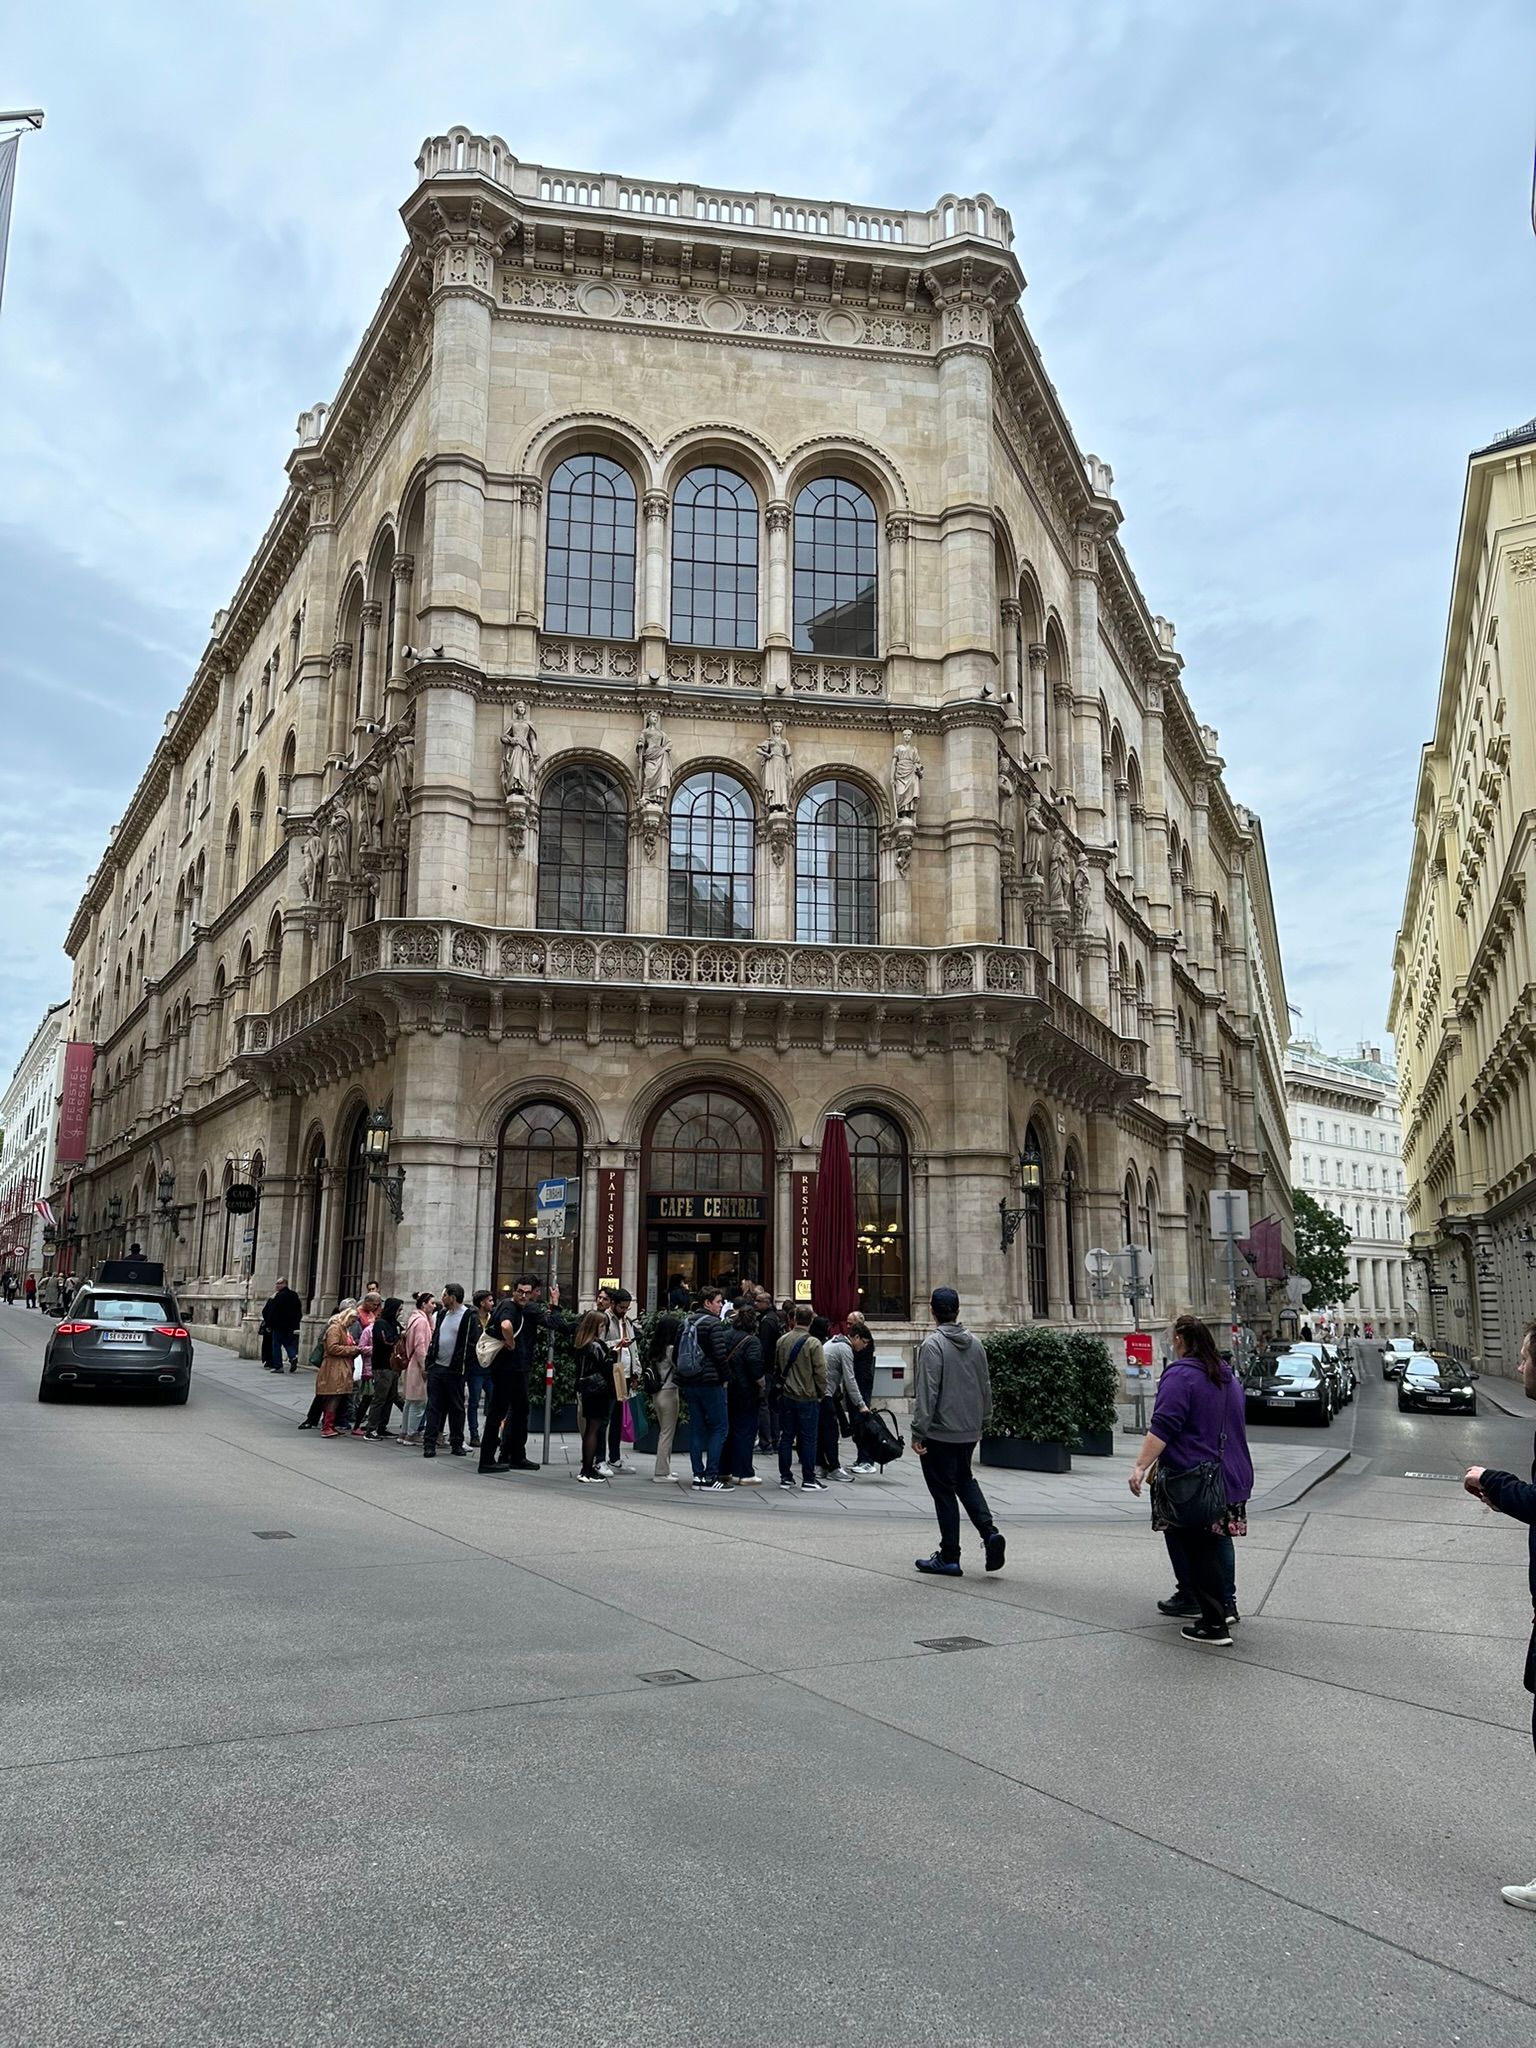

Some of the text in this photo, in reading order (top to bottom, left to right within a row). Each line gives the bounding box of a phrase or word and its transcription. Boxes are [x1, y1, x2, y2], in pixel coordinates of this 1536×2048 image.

[66, 1065, 79, 1120] FERSTEL
[76, 1066, 89, 1121] PASSAGE
[227, 1201, 254, 1209] CENTRAL
[606, 1172, 616, 1276] PATISSERIE
[660, 1197, 760, 1218] CAFE CENTRAL
[801, 1175, 809, 1278] RESTAURANT
